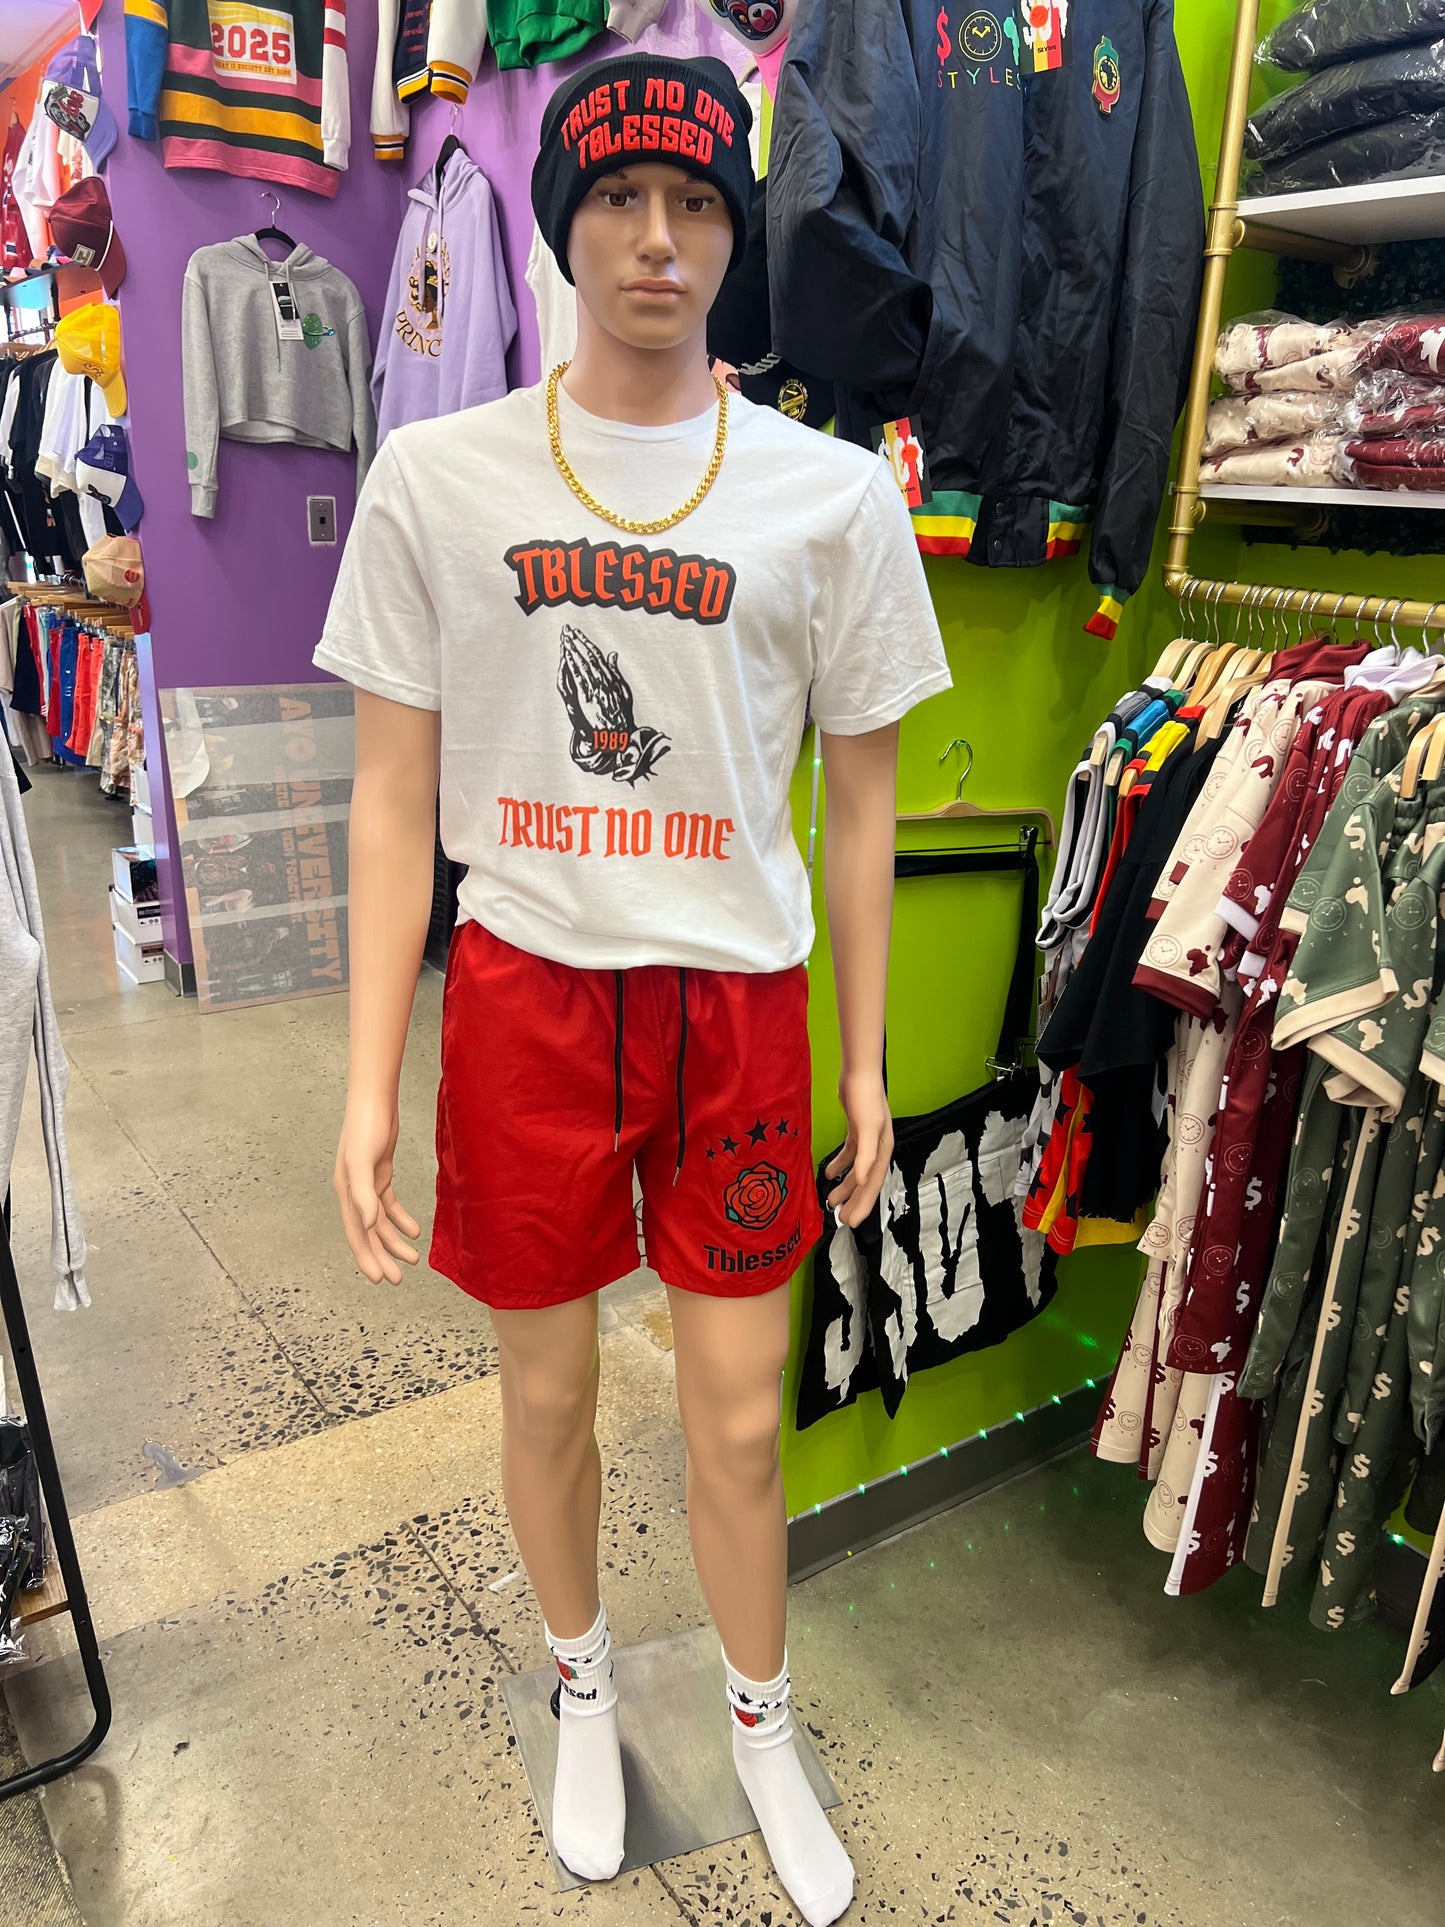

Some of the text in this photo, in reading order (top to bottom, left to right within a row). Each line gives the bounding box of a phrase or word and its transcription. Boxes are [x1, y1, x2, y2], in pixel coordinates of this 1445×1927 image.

[211, 22, 291, 65] 2025
[560, 77, 735, 152] TRUST NO ONE
[511, 546, 730, 618] TBLESSED
[592, 730, 630, 752] 1989
[497, 796, 736, 861] TRUST NO ONE
[703, 1218, 801, 1273] Tblessed
